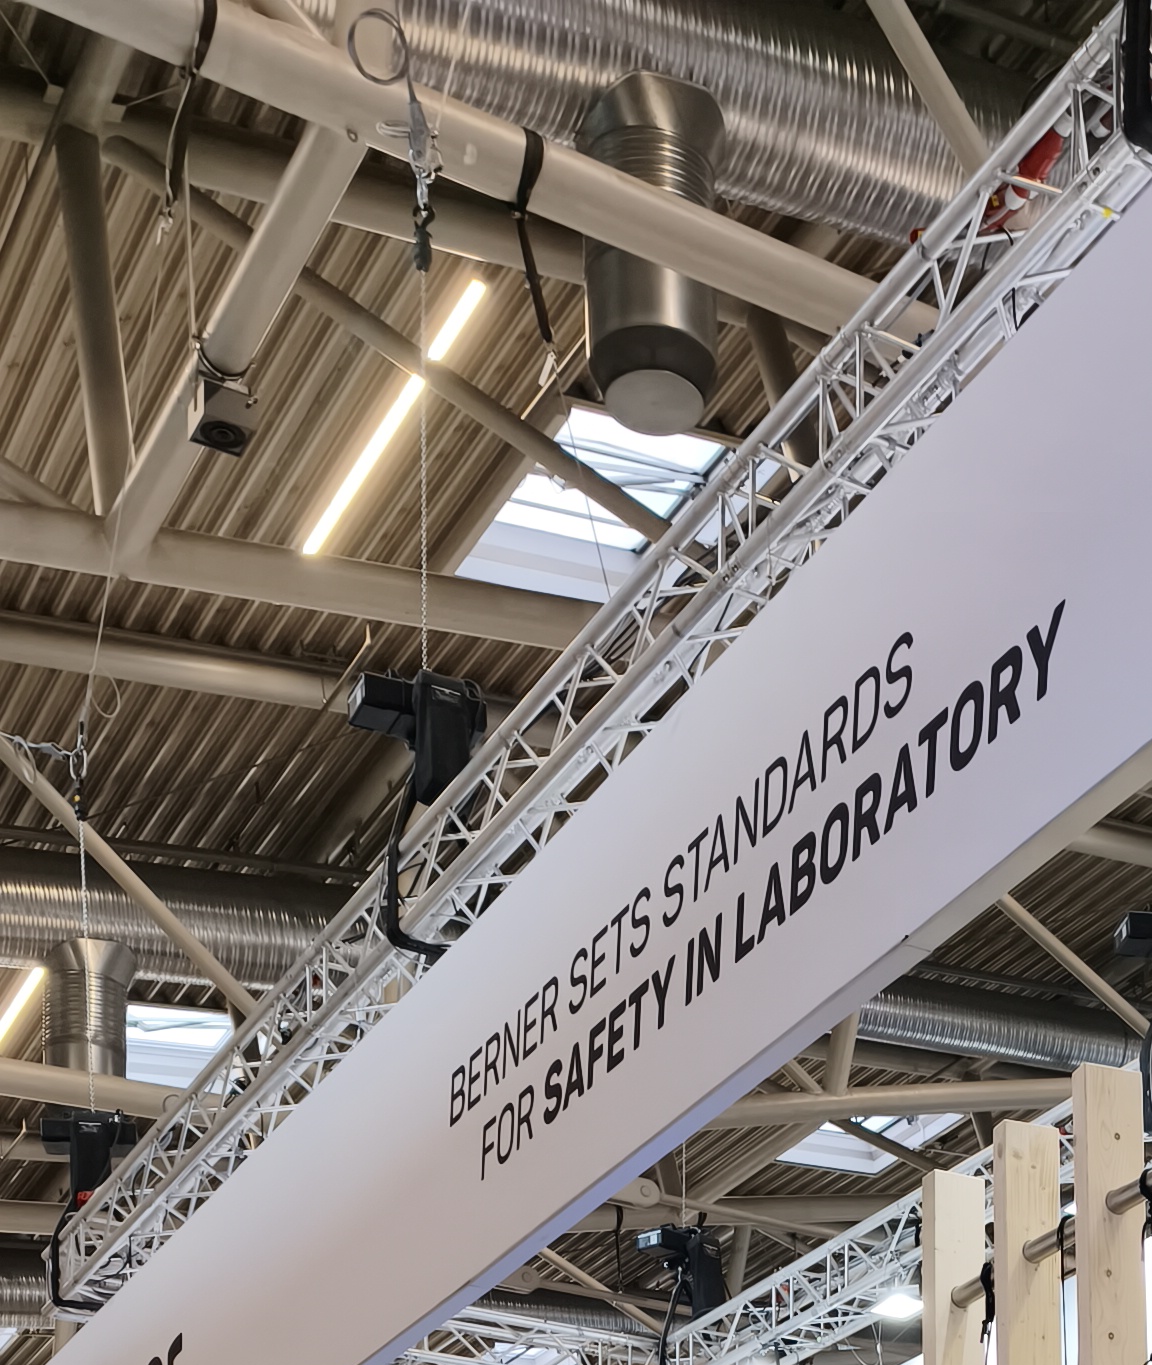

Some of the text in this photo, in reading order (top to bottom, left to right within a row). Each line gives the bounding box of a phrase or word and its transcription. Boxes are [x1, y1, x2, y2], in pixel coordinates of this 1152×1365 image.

[450, 631, 914, 1128] BERNER SETS STANDARDS
[479, 600, 1067, 1182] FOR SAFETY IN LABORATORY
